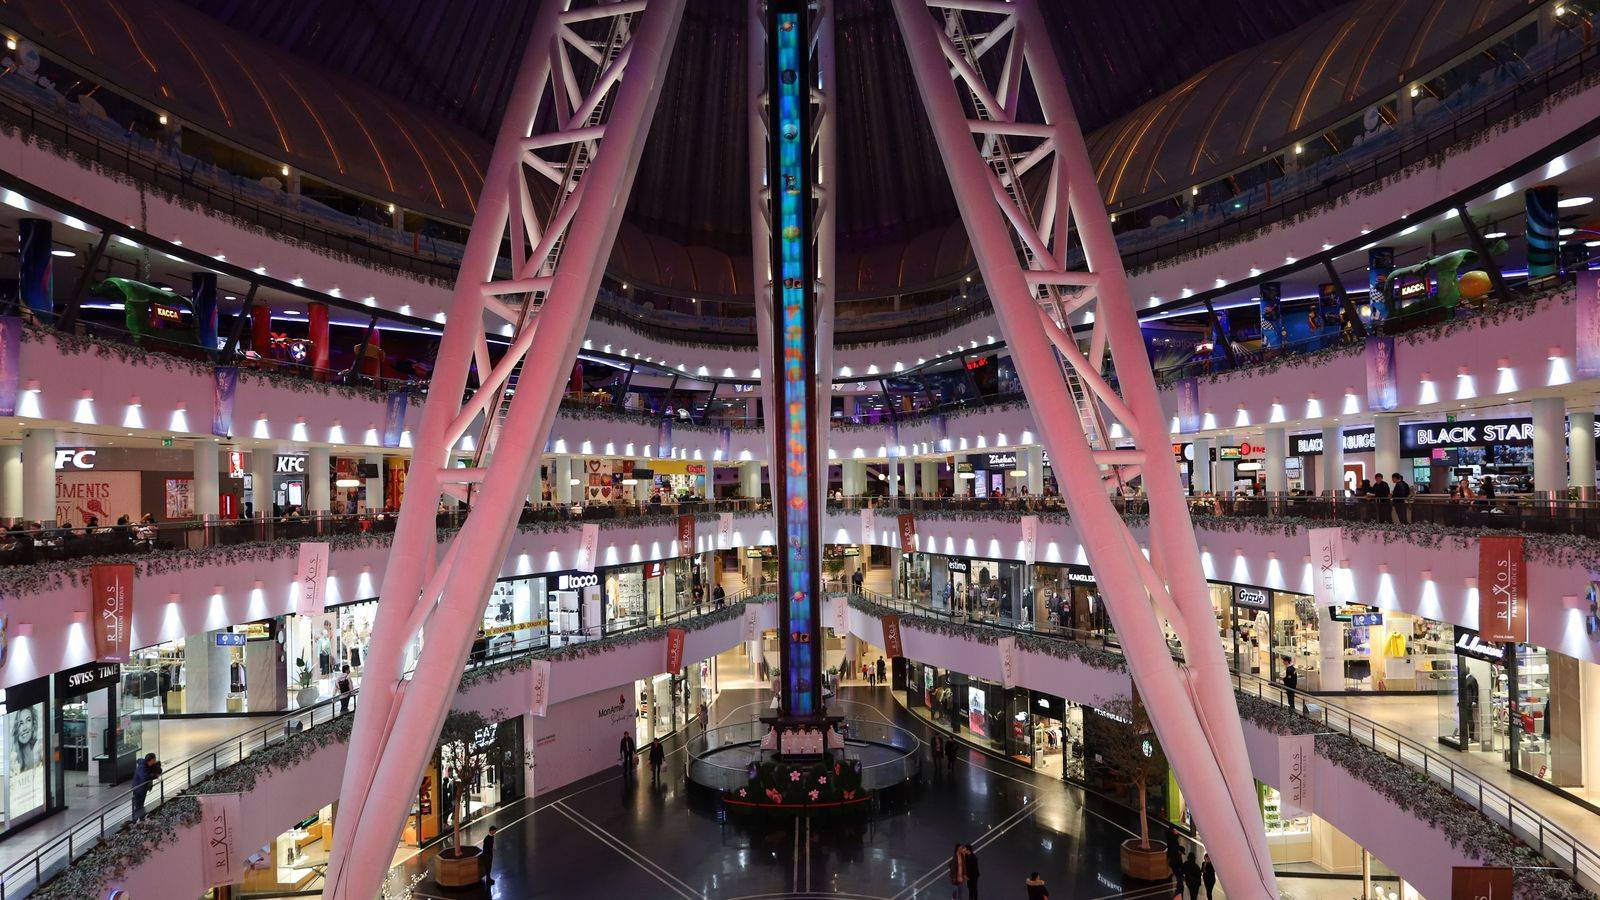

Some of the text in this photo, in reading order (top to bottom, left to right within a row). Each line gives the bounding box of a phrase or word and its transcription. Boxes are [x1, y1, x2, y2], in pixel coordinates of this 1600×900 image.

[157, 307, 179, 319] КАССА
[1347, 433, 1376, 449] BURGE
[1417, 424, 1534, 445] BLACK STAR
[54, 450, 96, 469] FC
[276, 456, 305, 473] KFC
[56, 483, 110, 499] MENTS
[1321, 545, 1334, 590] RIXOS
[305, 558, 317, 599] RIXOS
[569, 574, 598, 588] tocco
[1239, 589, 1266, 604] Grazie
[1492, 560, 1510, 619] RIXOS
[103, 586, 118, 642] RIXOS
[69, 664, 119, 687] SWISS TIME
[1289, 753, 1302, 801] RIXOS
[210, 815, 227, 868] RIXOS
